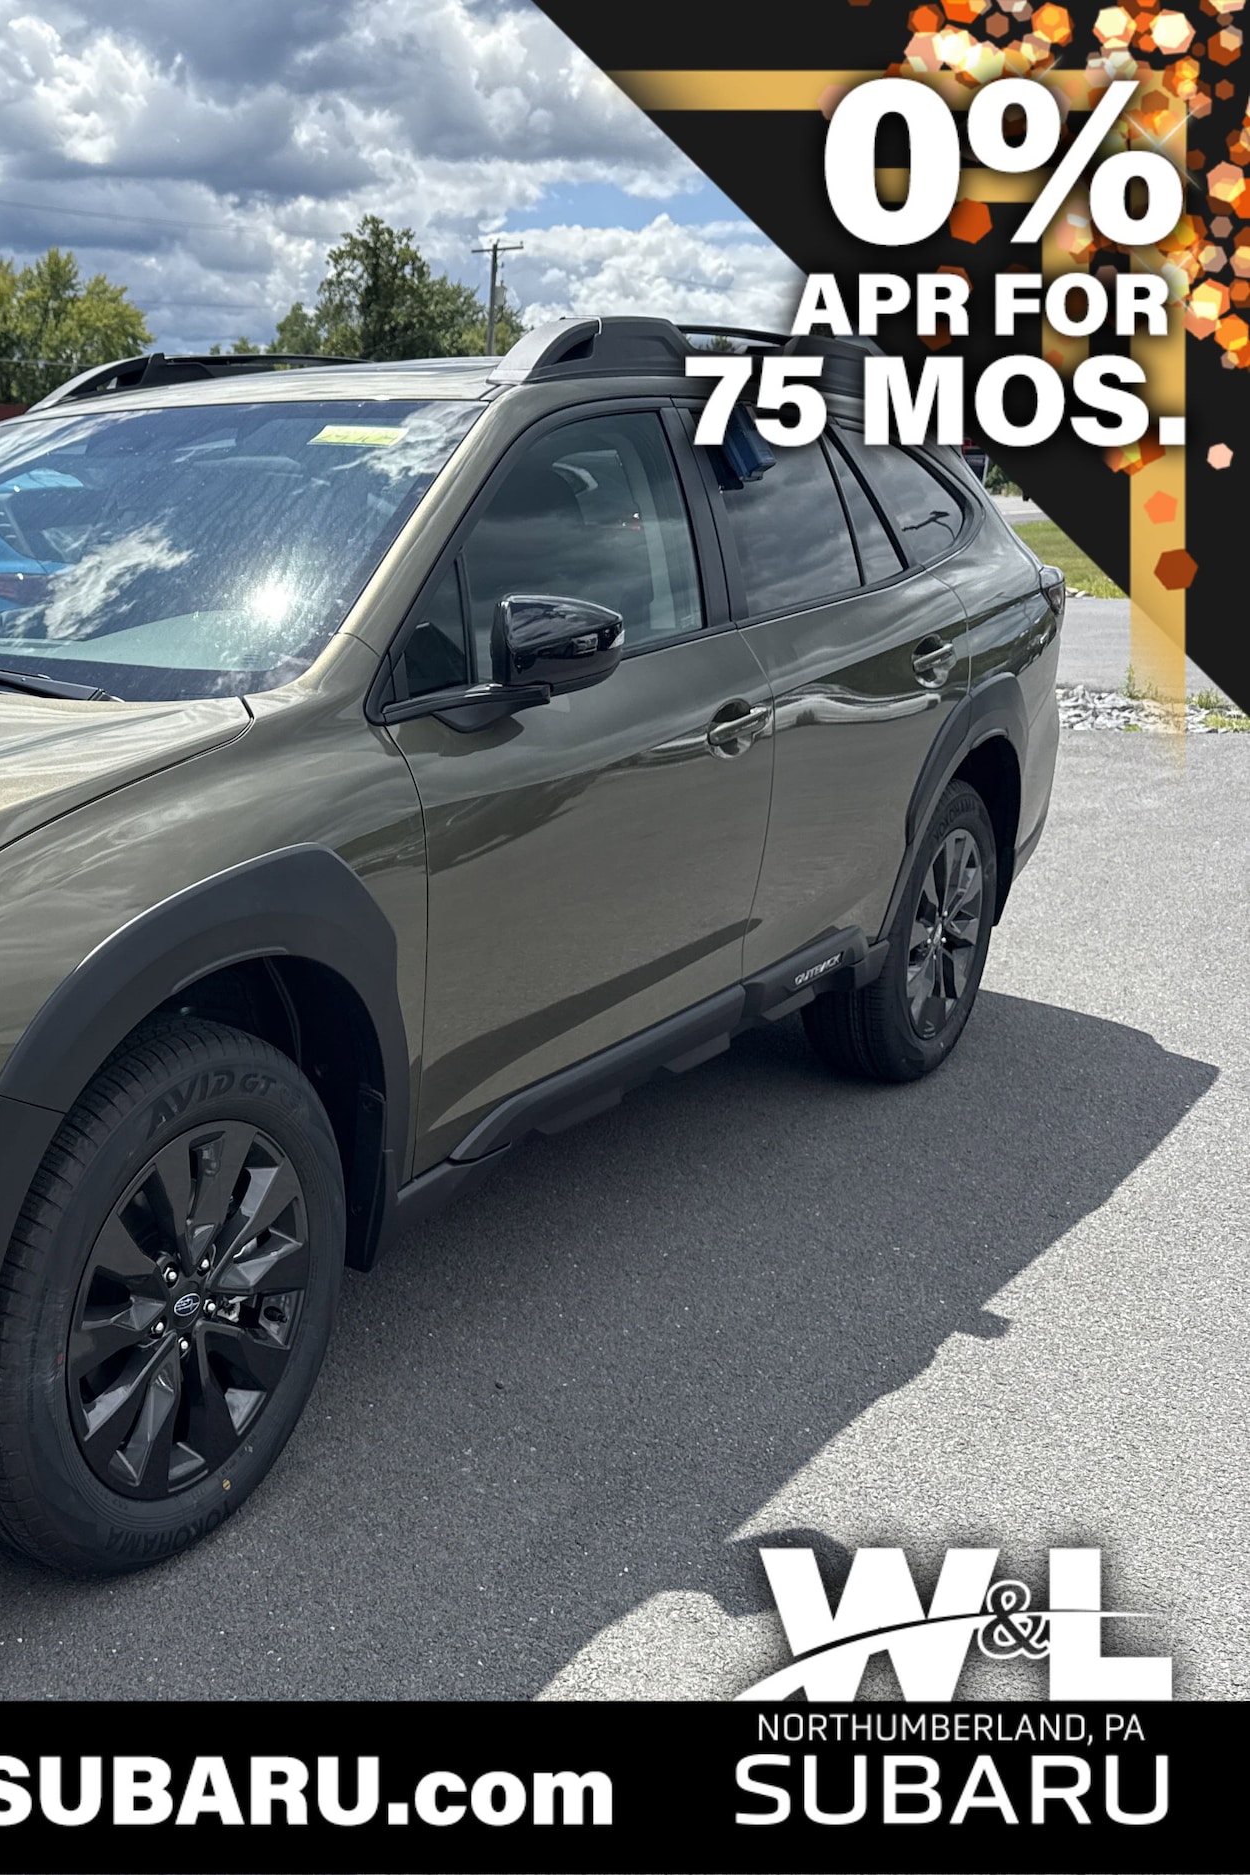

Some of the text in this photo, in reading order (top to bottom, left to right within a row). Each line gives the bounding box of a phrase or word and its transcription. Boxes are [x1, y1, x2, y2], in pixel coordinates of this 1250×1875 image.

[146, 1069, 235, 1140] AVID
[239, 1073, 276, 1097] GT
[104, 1500, 232, 1558] YOKOHAMA
